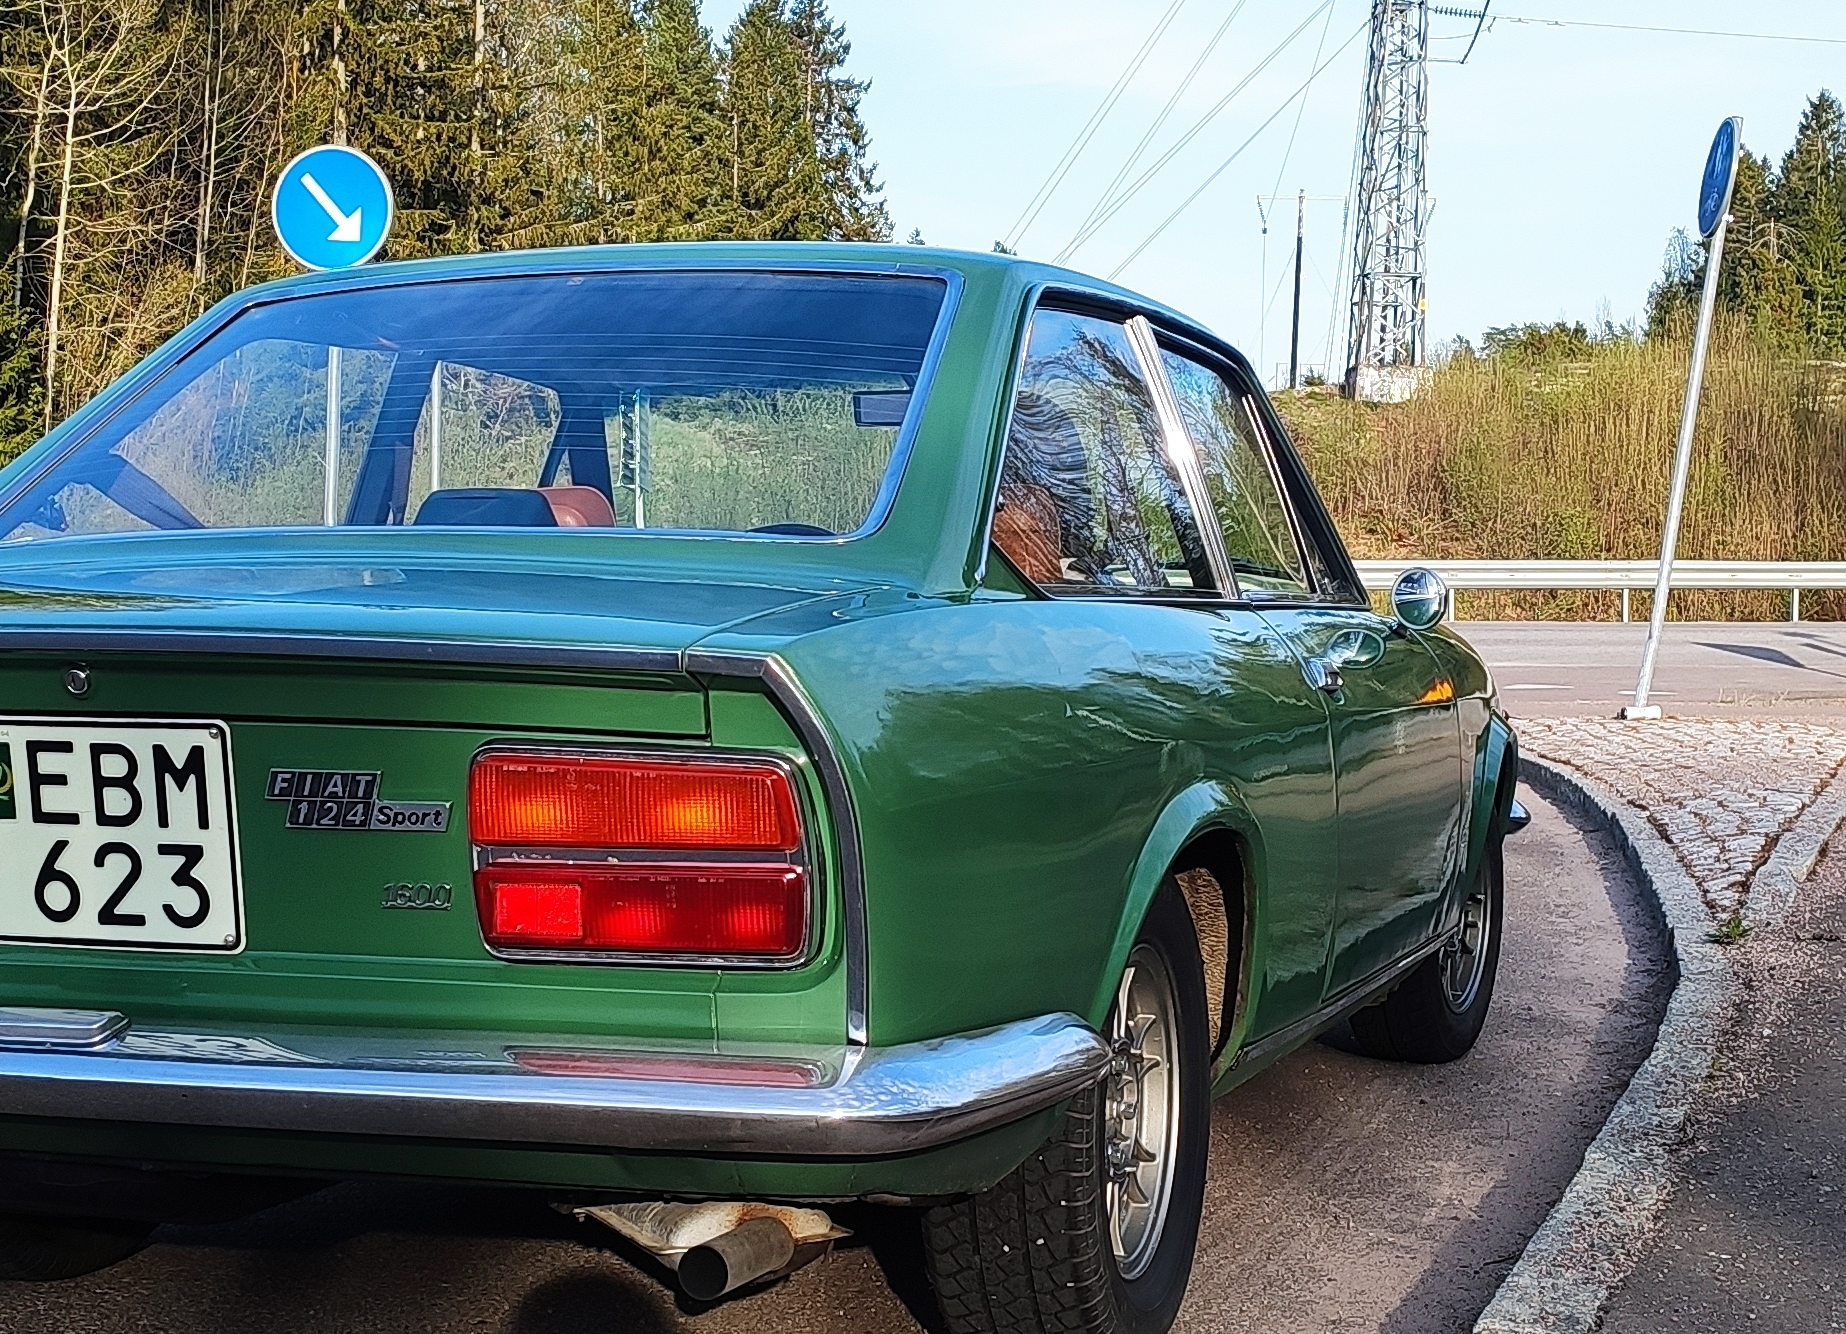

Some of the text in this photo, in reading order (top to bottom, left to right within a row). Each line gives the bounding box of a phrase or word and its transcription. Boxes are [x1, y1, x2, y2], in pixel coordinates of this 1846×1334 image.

[26, 740, 210, 830] EBM
[273, 773, 373, 798] FIAT
[296, 801, 443, 828] 124 Sport
[34, 840, 211, 929] 623
[382, 882, 453, 910] 1600
